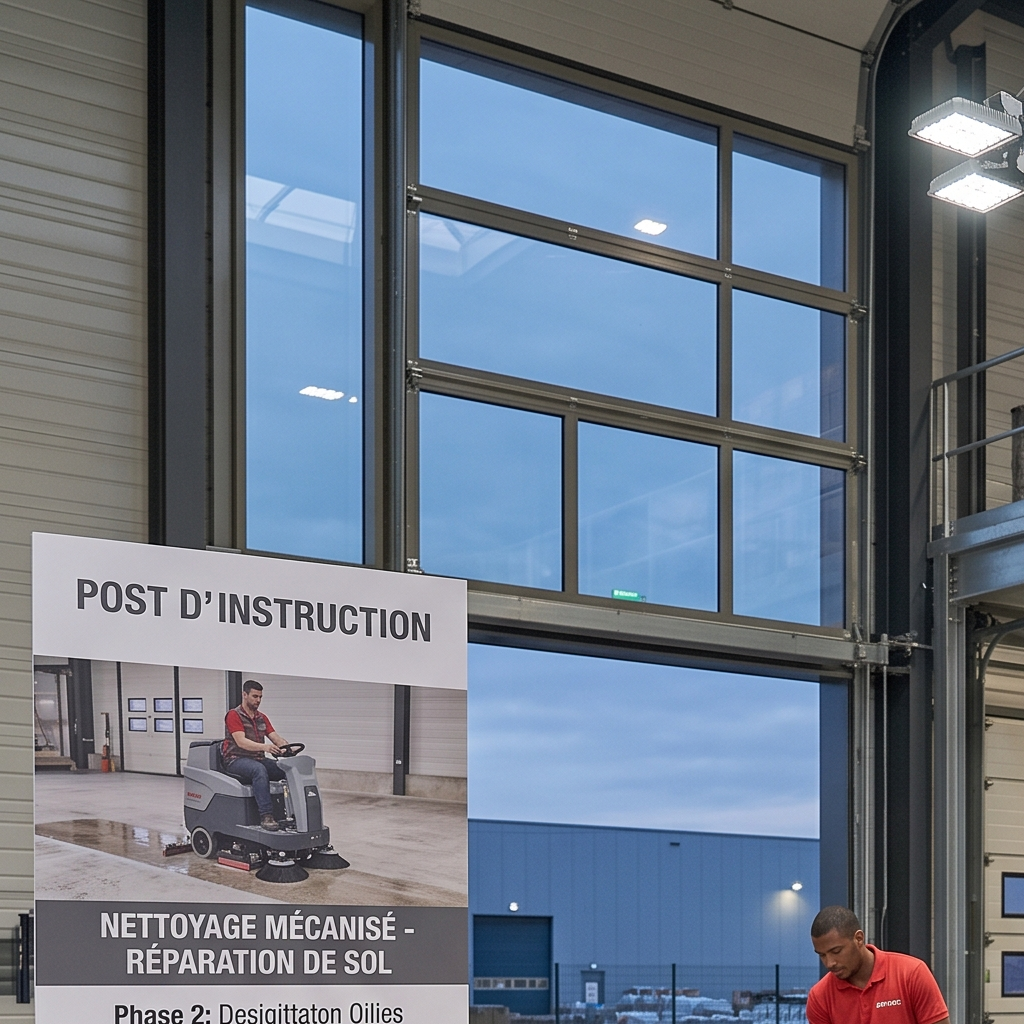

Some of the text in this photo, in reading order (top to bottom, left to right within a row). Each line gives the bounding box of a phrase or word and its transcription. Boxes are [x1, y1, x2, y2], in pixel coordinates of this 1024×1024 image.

[77, 578, 168, 617] POST
[100, 912, 257, 940] NETTOYAGE
[265, 909, 397, 941] MÉCANISÉ
[126, 943, 393, 975] RÉPARATION DE SOL
[350, 1002, 403, 1024] Oilies
